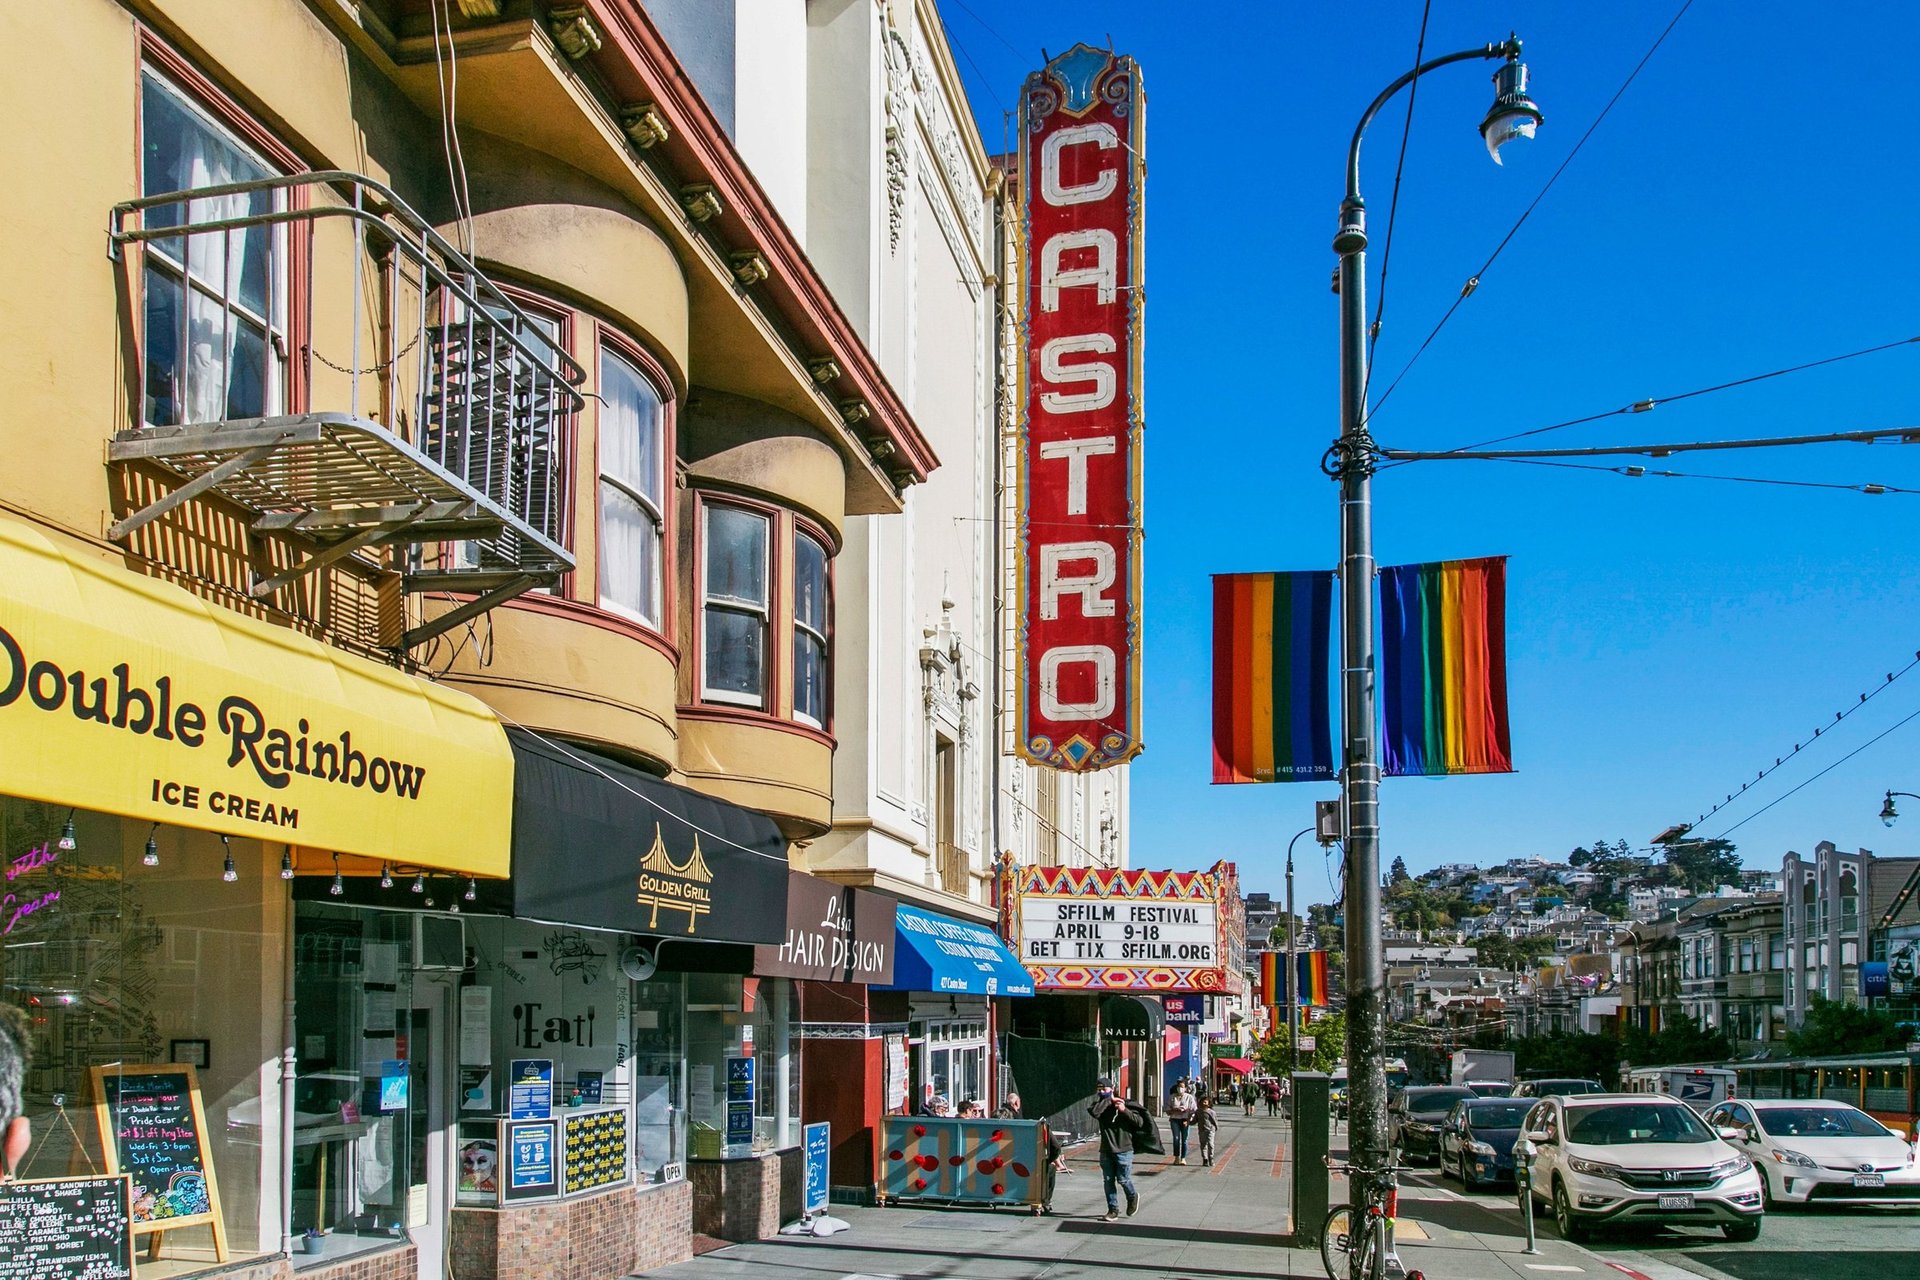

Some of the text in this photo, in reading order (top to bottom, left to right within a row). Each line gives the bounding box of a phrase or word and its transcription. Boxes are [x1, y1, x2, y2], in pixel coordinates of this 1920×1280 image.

[1040, 122, 1117, 722] CASTRO
[217, 695, 426, 800] Rainbow
[152, 779, 298, 829] ICE CREAM
[639, 873, 711, 902] GOLDEN GRILL
[820, 895, 852, 932] Lisa
[1058, 904, 1198, 924] SFFILM FESTIVAL
[931, 919, 967, 941] COFFEE
[1055, 923, 1160, 941] APRIL 9-18
[779, 928, 884, 973] HAIR DESIGN
[1031, 941, 1060, 957] GET
[1075, 942, 1105, 958] TIX
[1122, 943, 1211, 960] SFFILM.ORG
[1166, 1001, 1184, 1010] us
[1166, 1010, 1200, 1021] bank
[522, 1003, 586, 1049] Eat
[1106, 1027, 1147, 1036] NAILS
[129, 1115, 177, 1125] Pride Gear
[147, 1128, 159, 1138] off
[161, 1128, 177, 1140] Any
[132, 1152, 150, 1164] Sat
[156, 1152, 172, 1162] Sun
[665, 1166, 681, 1180] OPEN
[30, 1183, 57, 1192] CREAM
[60, 1180, 108, 1190] SANDWICHES
[54, 1188, 83, 1198] SHAKES
[33, 1202, 56, 1211] BLAST
[30, 1214, 73, 1223] CHOCOLATE
[28, 1224, 97, 1236] CARAMEL TRUFFLE
[30, 1234, 70, 1243] PISTACHIO
[55, 1241, 85, 1250] SORBET
[37, 1255, 85, 1266] STRAWBERRY
[85, 1252, 110, 1262] LEMON
[36, 1265, 55, 1274] CHIP
